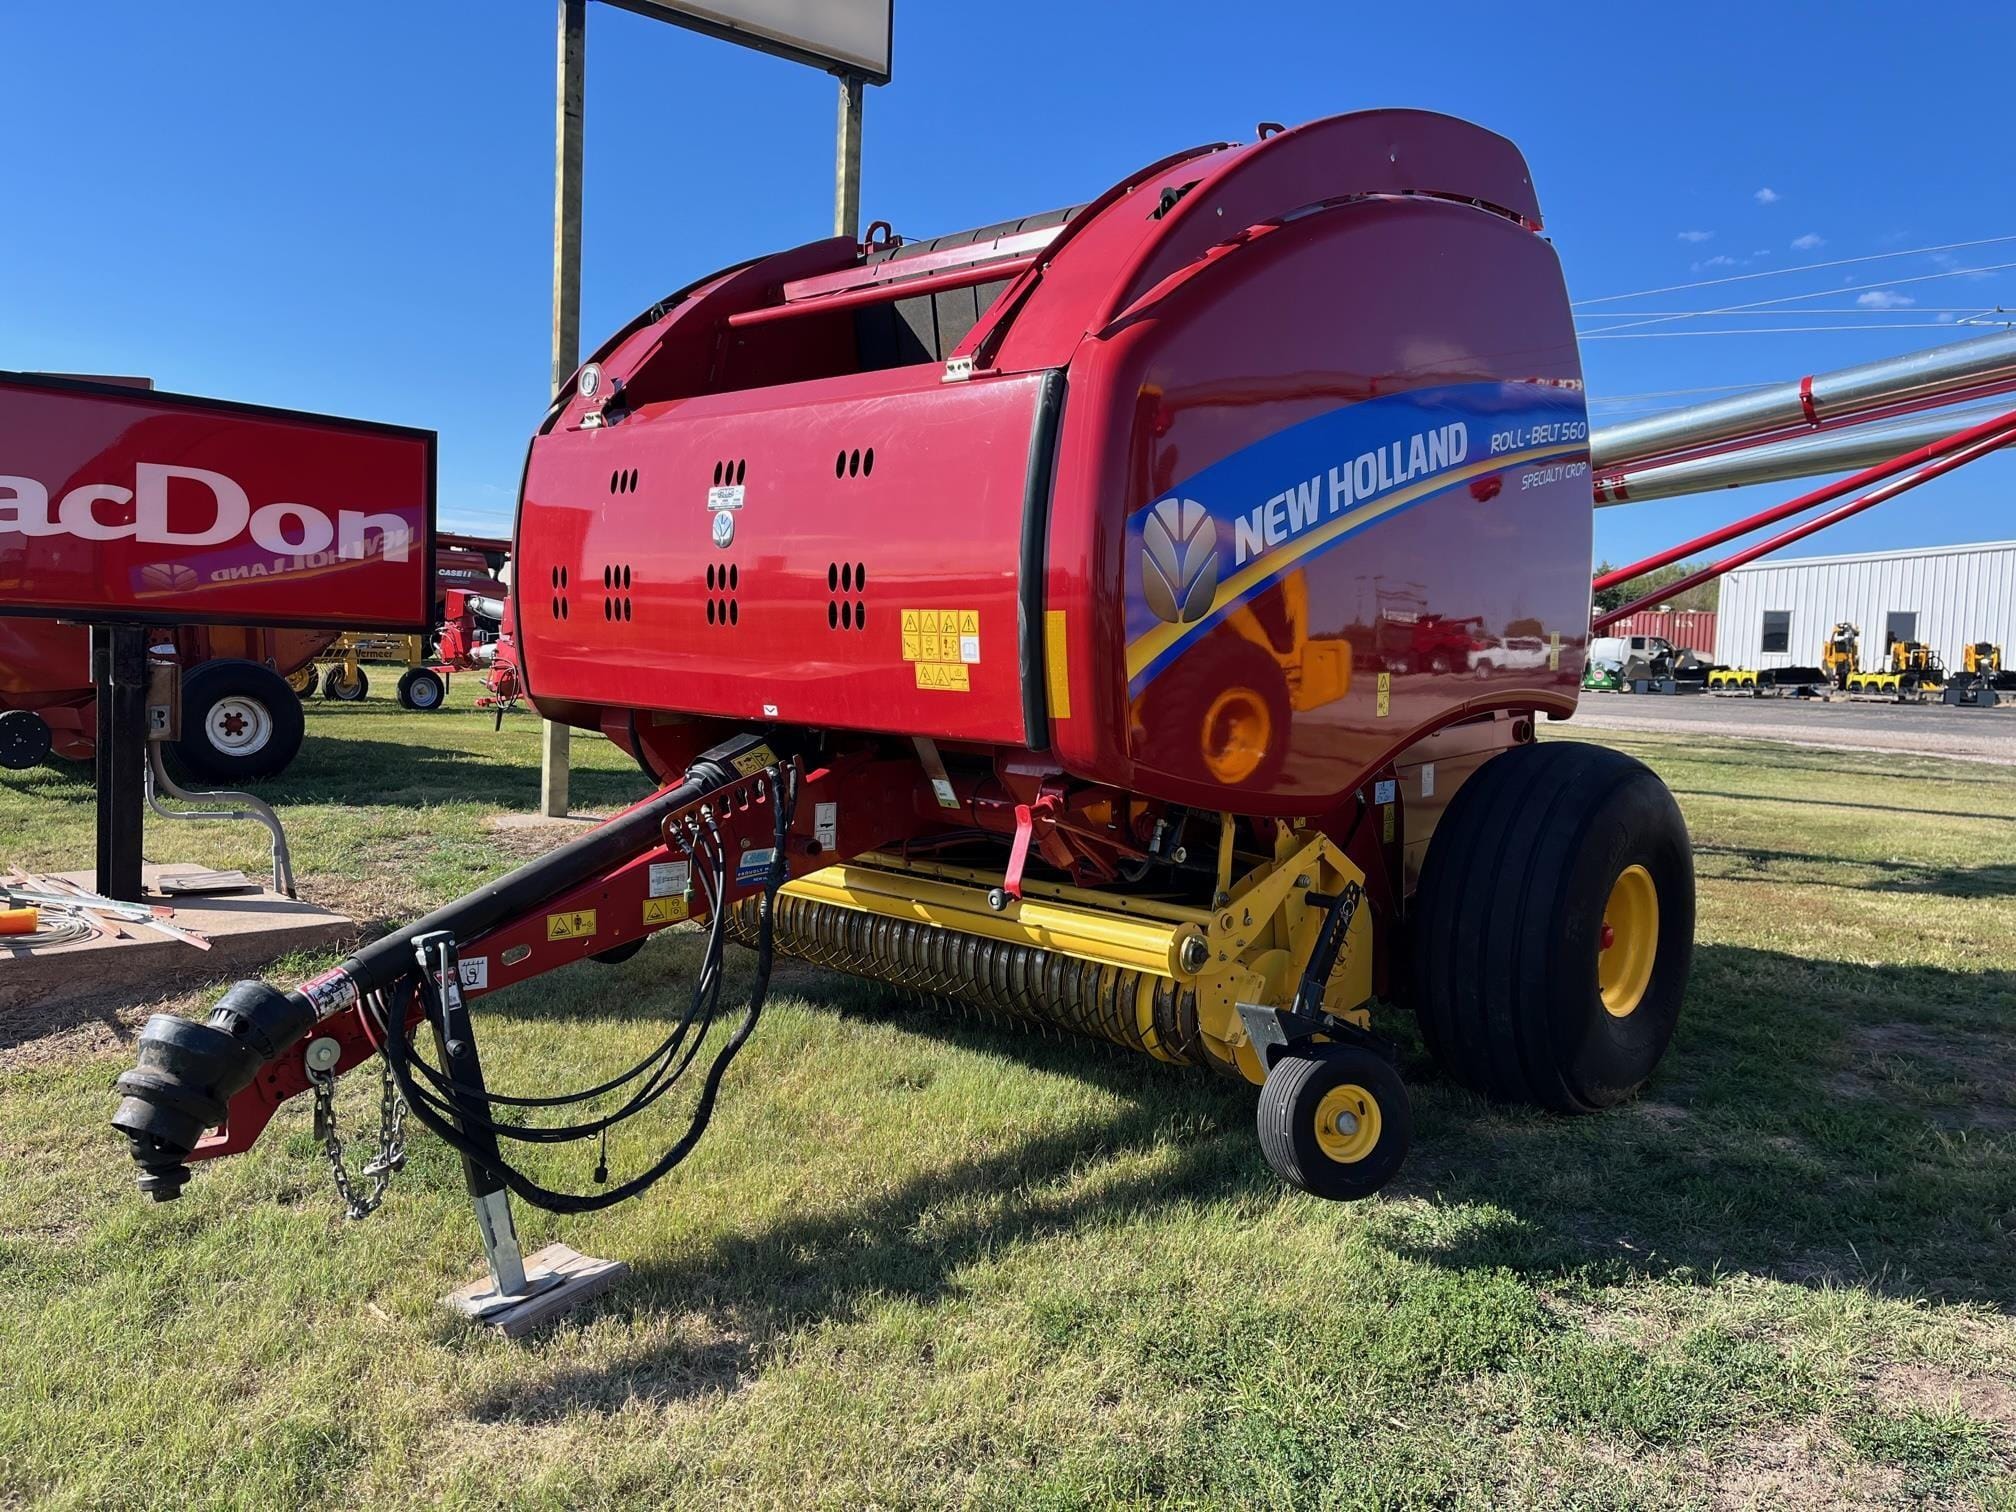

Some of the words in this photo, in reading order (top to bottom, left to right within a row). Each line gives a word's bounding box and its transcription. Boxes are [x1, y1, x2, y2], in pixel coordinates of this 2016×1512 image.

[1561, 421, 1587, 441] 560
[1521, 466, 1565, 491] SPECIALTY
[1565, 461, 1587, 479] CROP
[1234, 475, 1322, 567] NEW
[1328, 421, 1468, 514] HOLLAND
[438, 568, 463, 577] CASE
[355, 648, 393, 658] Vermeer
